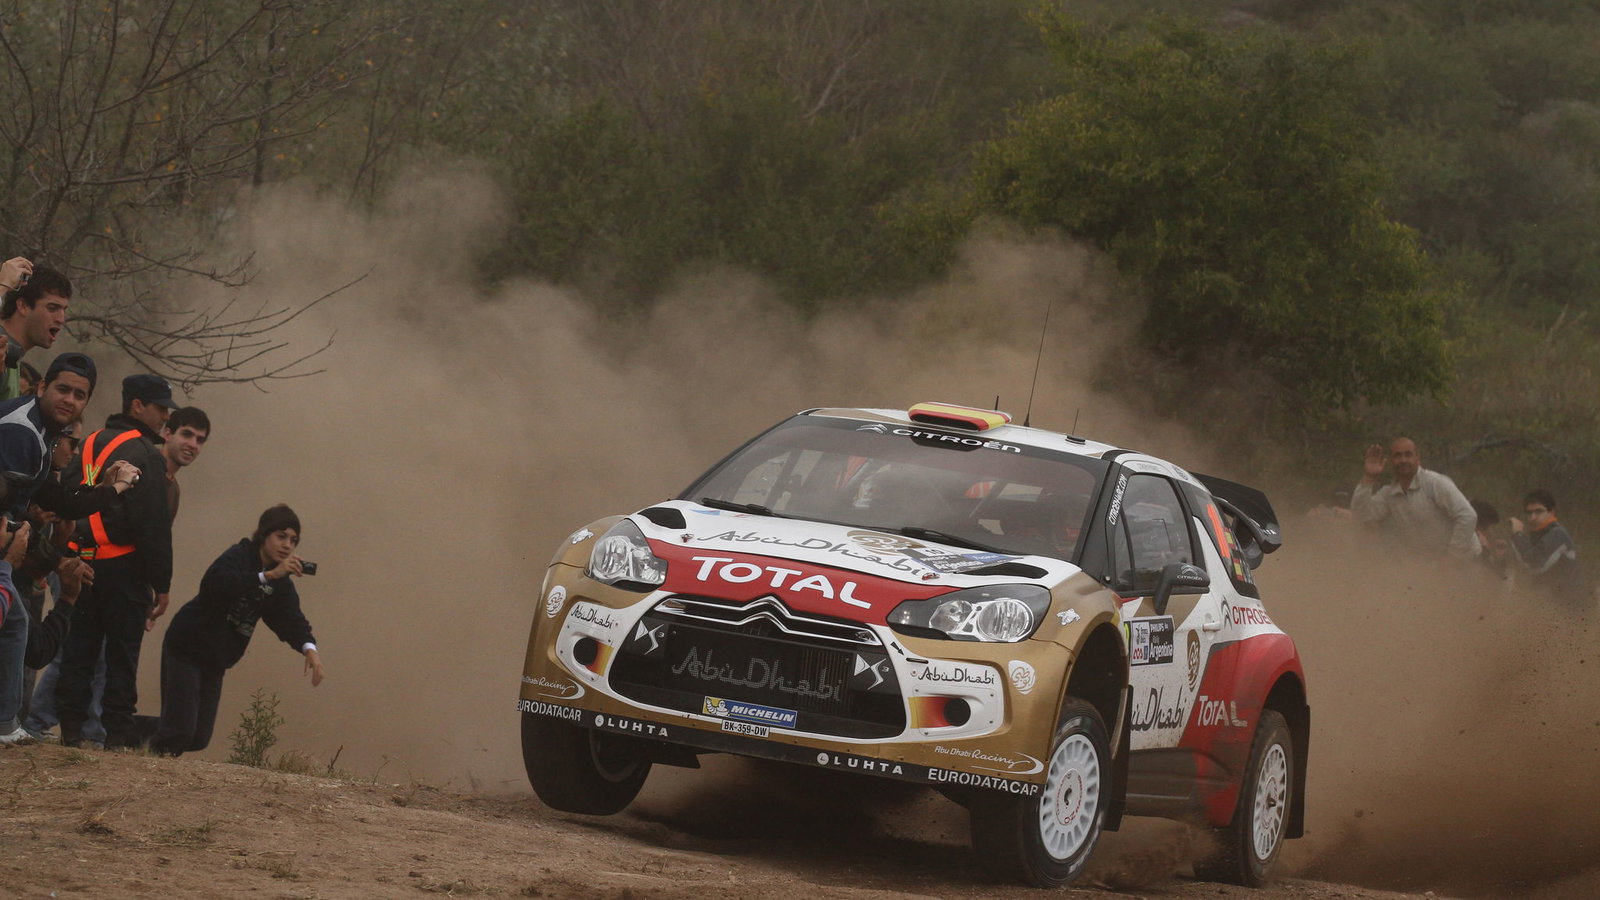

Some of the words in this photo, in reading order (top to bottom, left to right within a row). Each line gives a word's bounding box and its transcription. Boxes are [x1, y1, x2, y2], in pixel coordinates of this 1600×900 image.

[692, 556, 872, 610] TOTAL
[731, 705, 795, 722] MICHELIN
[1197, 695, 1248, 728] TOTAL
[607, 717, 668, 737] LUHTA
[724, 721, 768, 737] BK-359-DW
[834, 755, 903, 775] LUHTA
[934, 745, 949, 754] Abu
[950, 747, 971, 758] Dhabi
[971, 749, 1031, 769] Racing
[927, 768, 1039, 796] EURODATACAR
